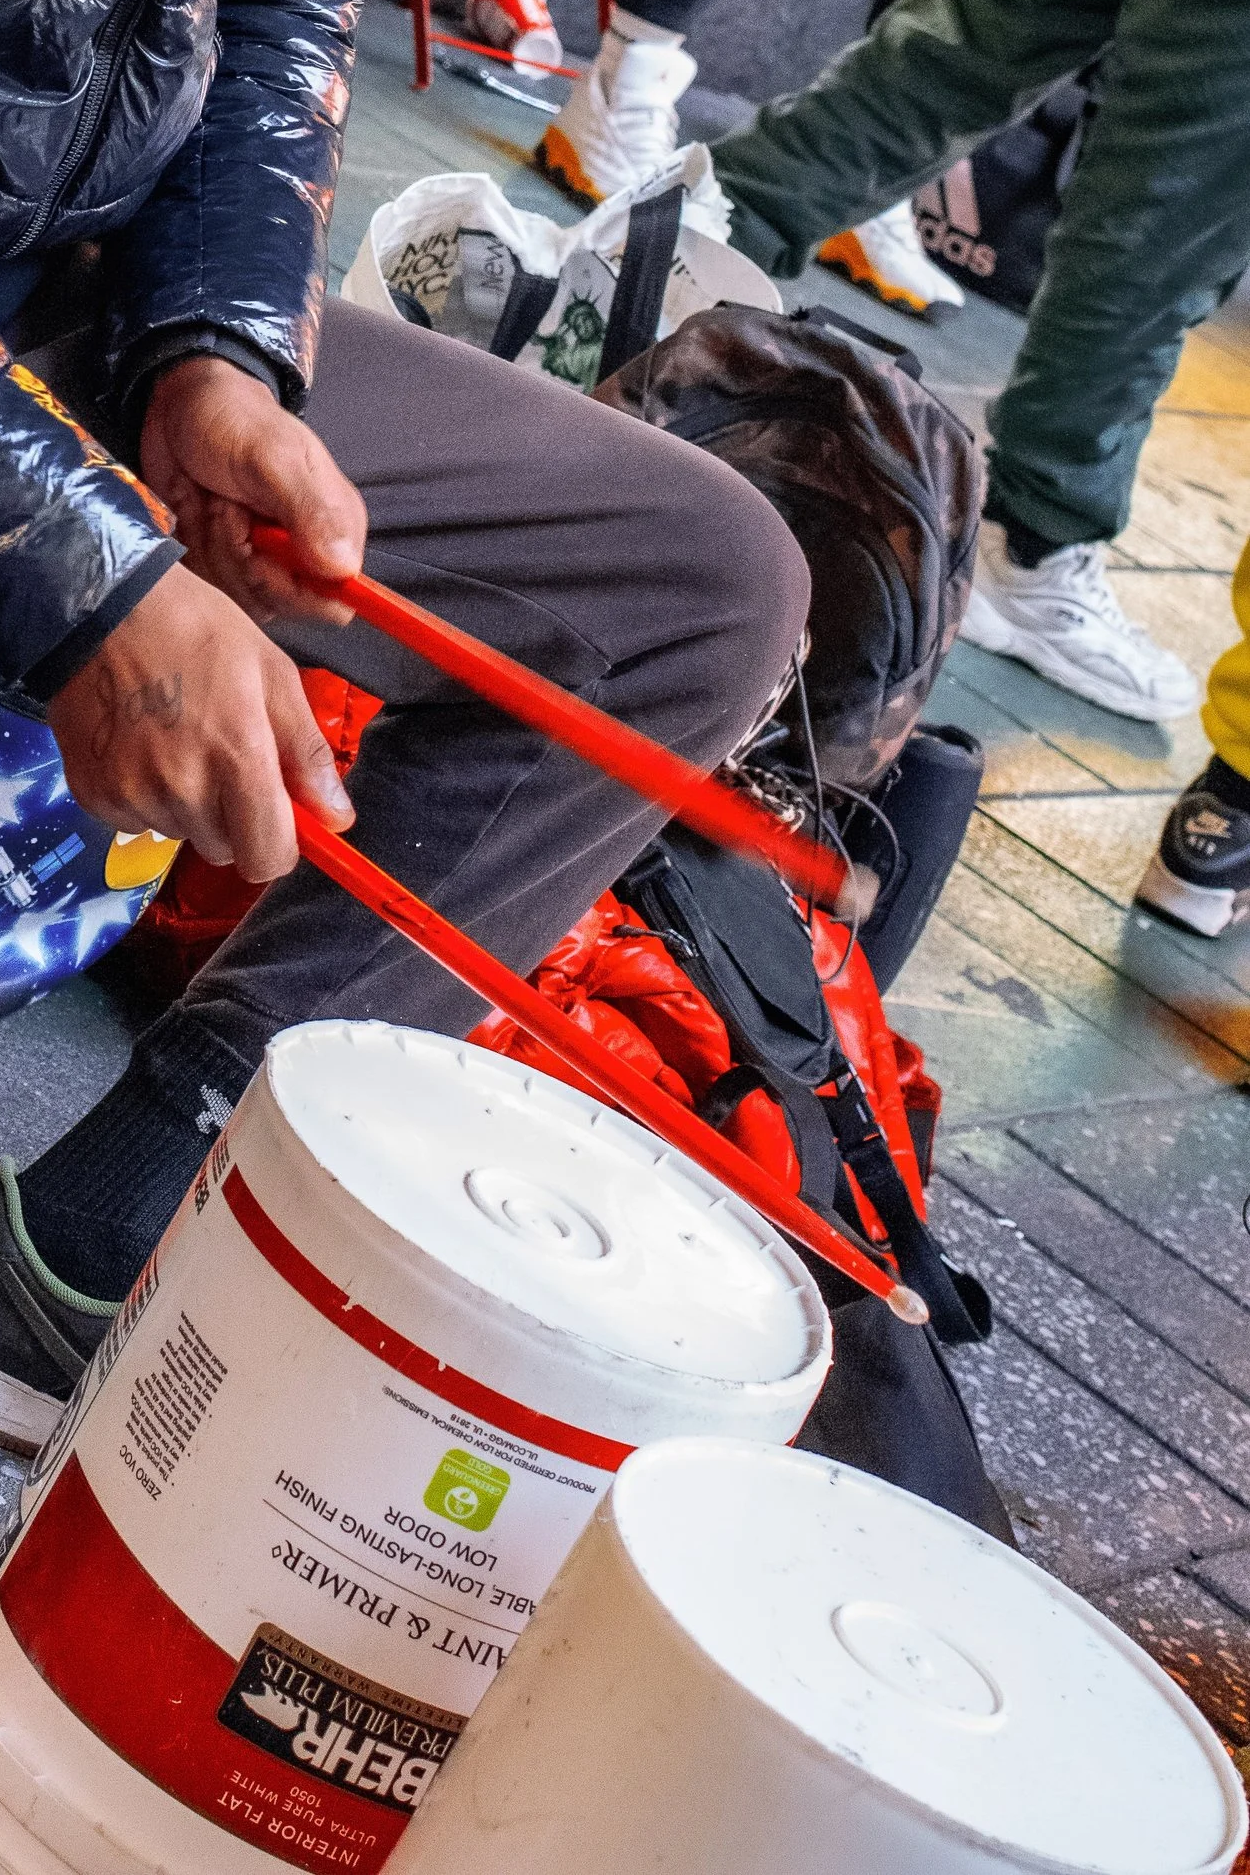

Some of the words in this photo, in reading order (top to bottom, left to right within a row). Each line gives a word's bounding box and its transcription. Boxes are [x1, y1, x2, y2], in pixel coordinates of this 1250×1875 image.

[119, 1444, 136, 1471] VOC
[473, 1438, 494, 1453] LOW
[494, 1447, 513, 1462] FOR
[134, 1467, 161, 1500] ZERO
[274, 1469, 338, 1523] FINISH
[382, 1505, 447, 1549] ODOR
[337, 1512, 484, 1598] LONG-LASTING
[446, 1539, 497, 1572] LOW
[280, 1538, 400, 1627] PRIMER
[487, 1583, 538, 1613] ABLE,
[403, 1610, 431, 1638] &
[431, 1625, 510, 1669] AINT
[327, 1690, 452, 1758] PREMIUM
[294, 1707, 440, 1806] BEHR
[229, 1769, 279, 1804] WHITE
[288, 1784, 322, 1808] 1050
[216, 1788, 264, 1823] FLAT
[281, 1798, 325, 1826] PURE
[267, 1816, 359, 1867] INTERIOR
[327, 1819, 375, 1846] ULTRA
